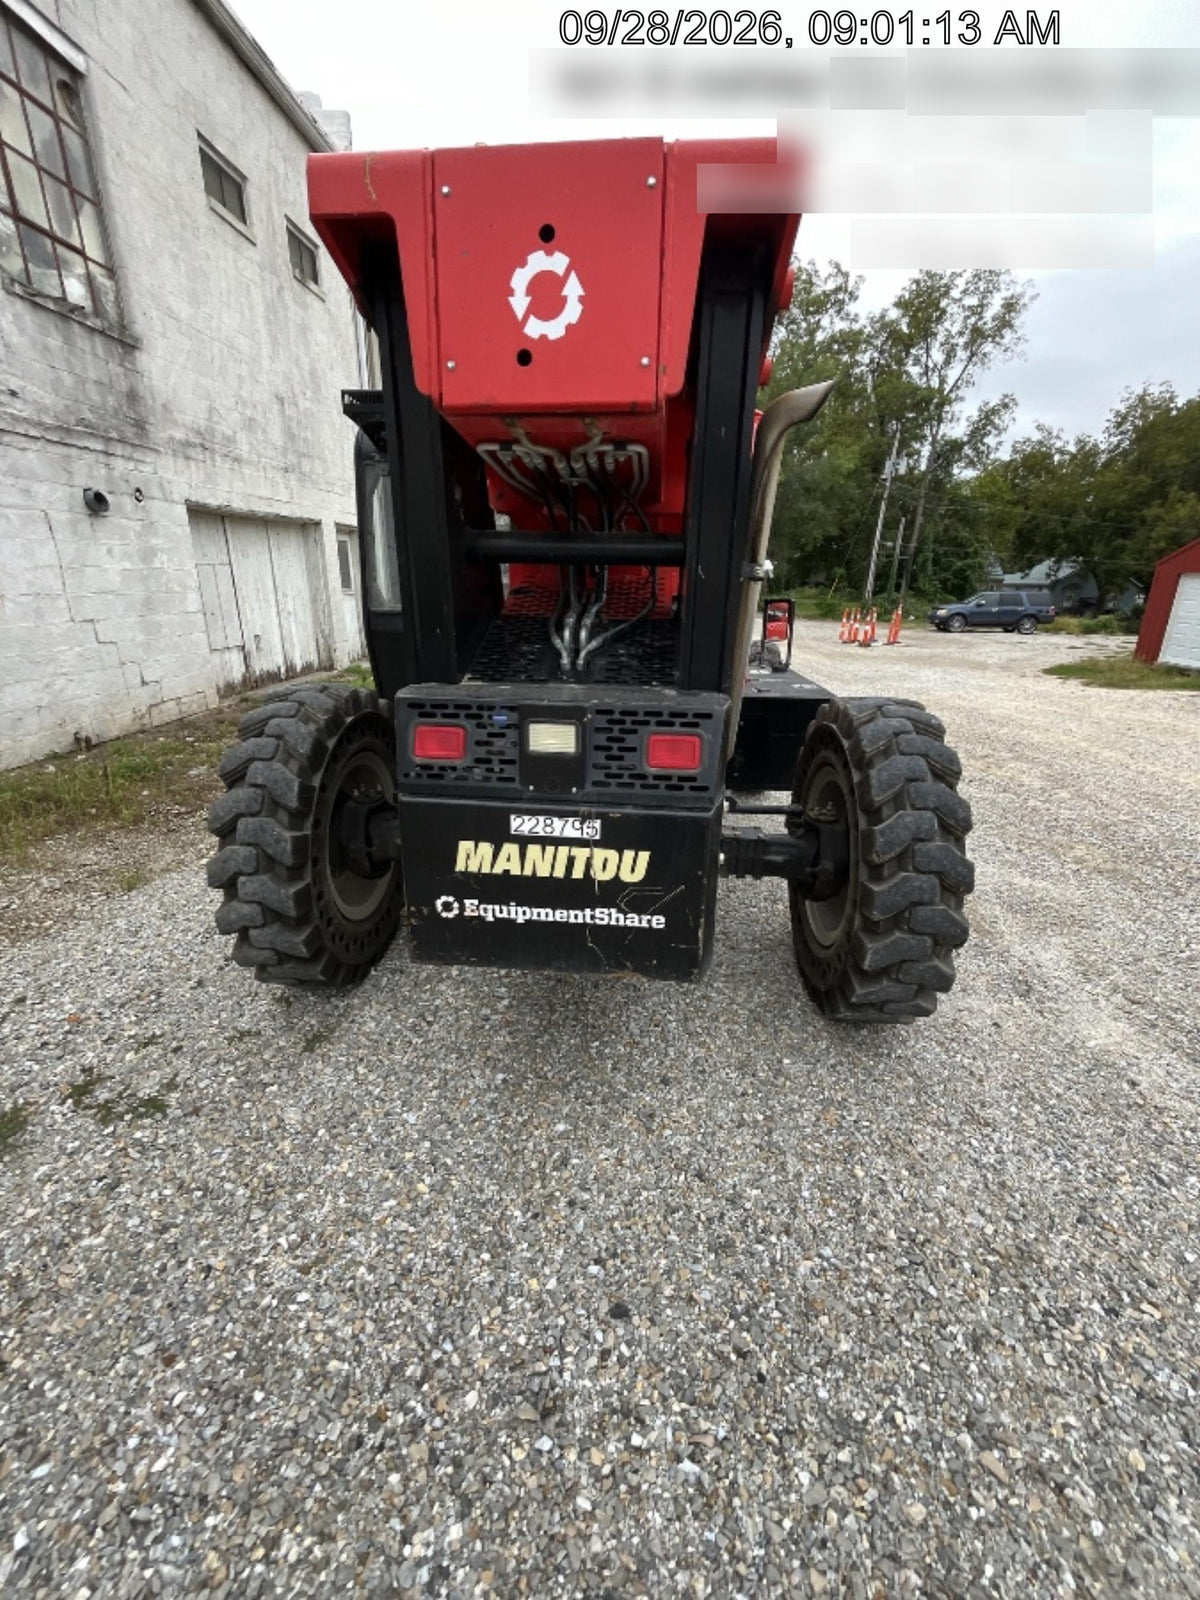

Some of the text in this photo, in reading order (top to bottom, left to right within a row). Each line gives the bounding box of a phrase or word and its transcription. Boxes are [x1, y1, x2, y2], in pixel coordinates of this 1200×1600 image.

[512, 815, 599, 838] 228795
[454, 840, 651, 882] MANITOU
[463, 899, 666, 929] EquipmentShare
